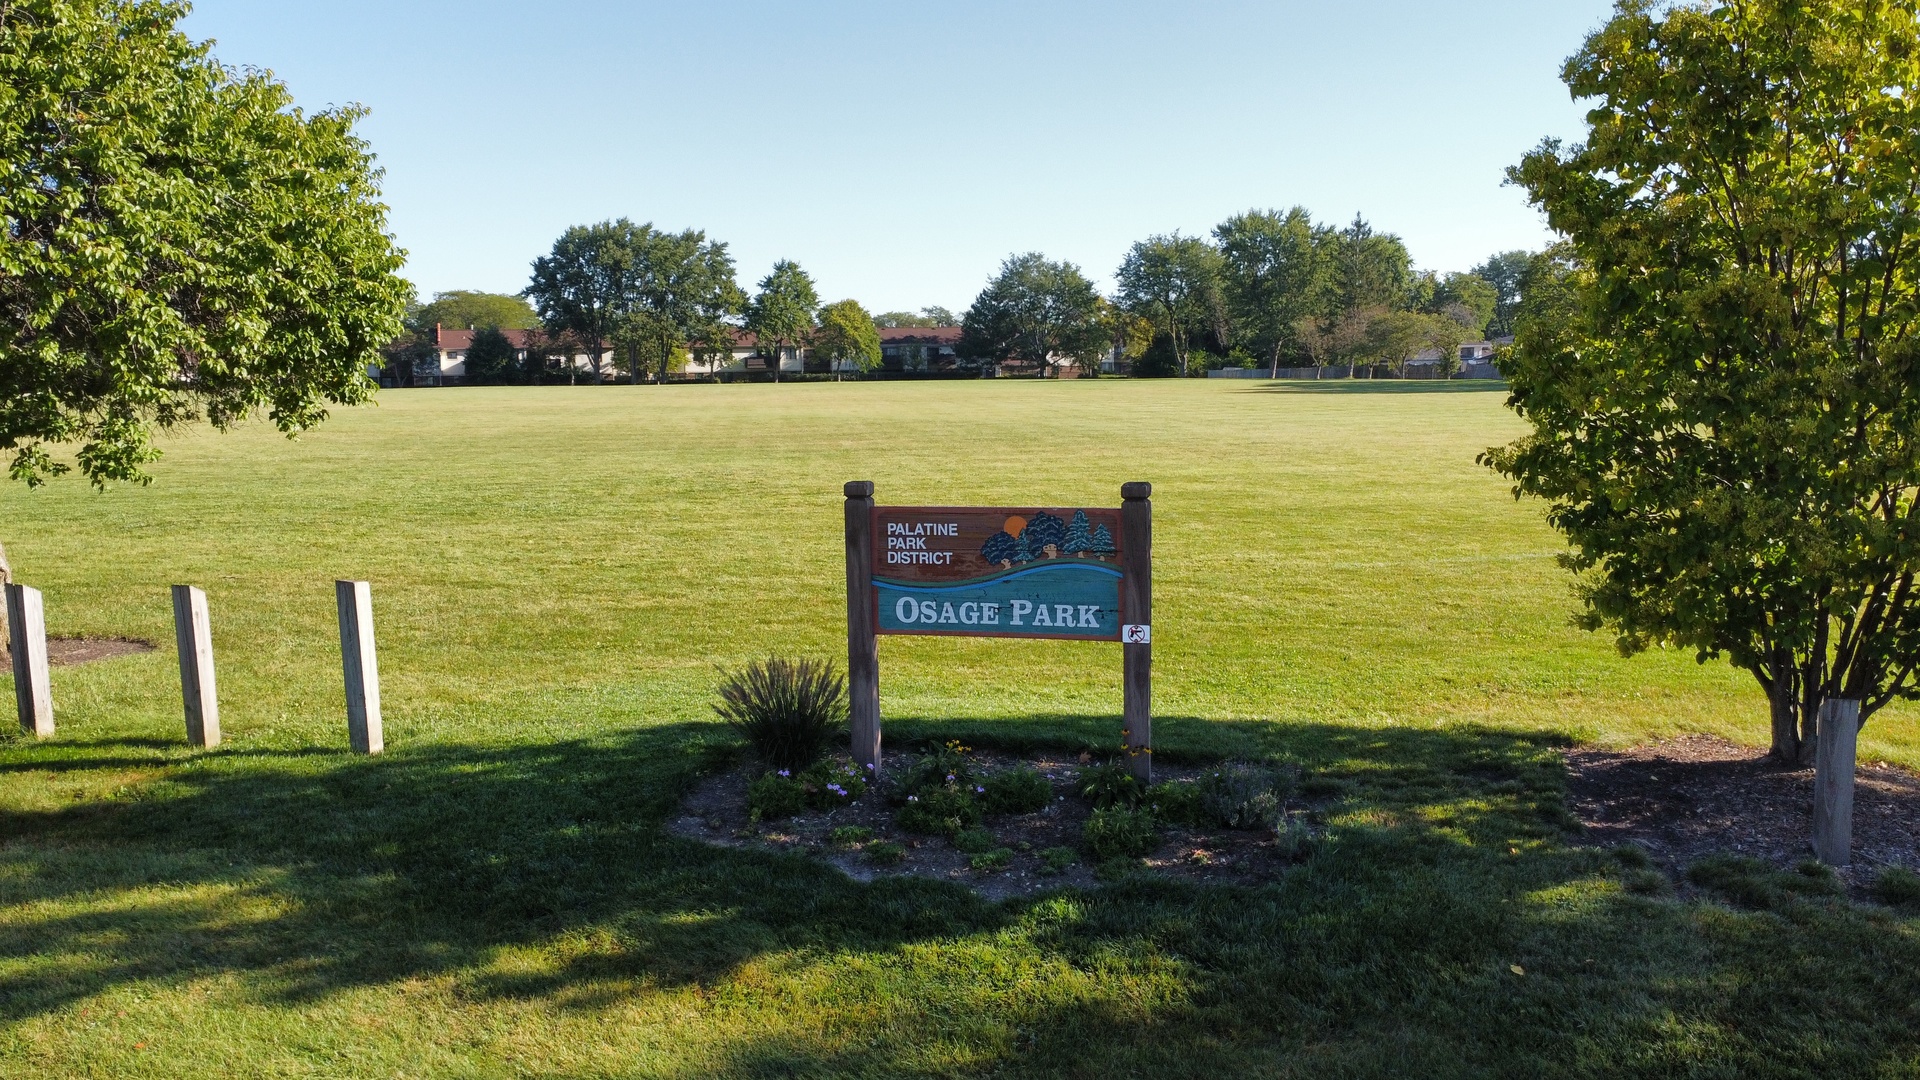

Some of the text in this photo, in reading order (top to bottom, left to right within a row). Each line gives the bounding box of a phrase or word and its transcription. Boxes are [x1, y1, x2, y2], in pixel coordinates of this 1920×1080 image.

[887, 523, 958, 536] PALATINE
[887, 537, 927, 550] PARK
[887, 551, 953, 564] DISTRICT
